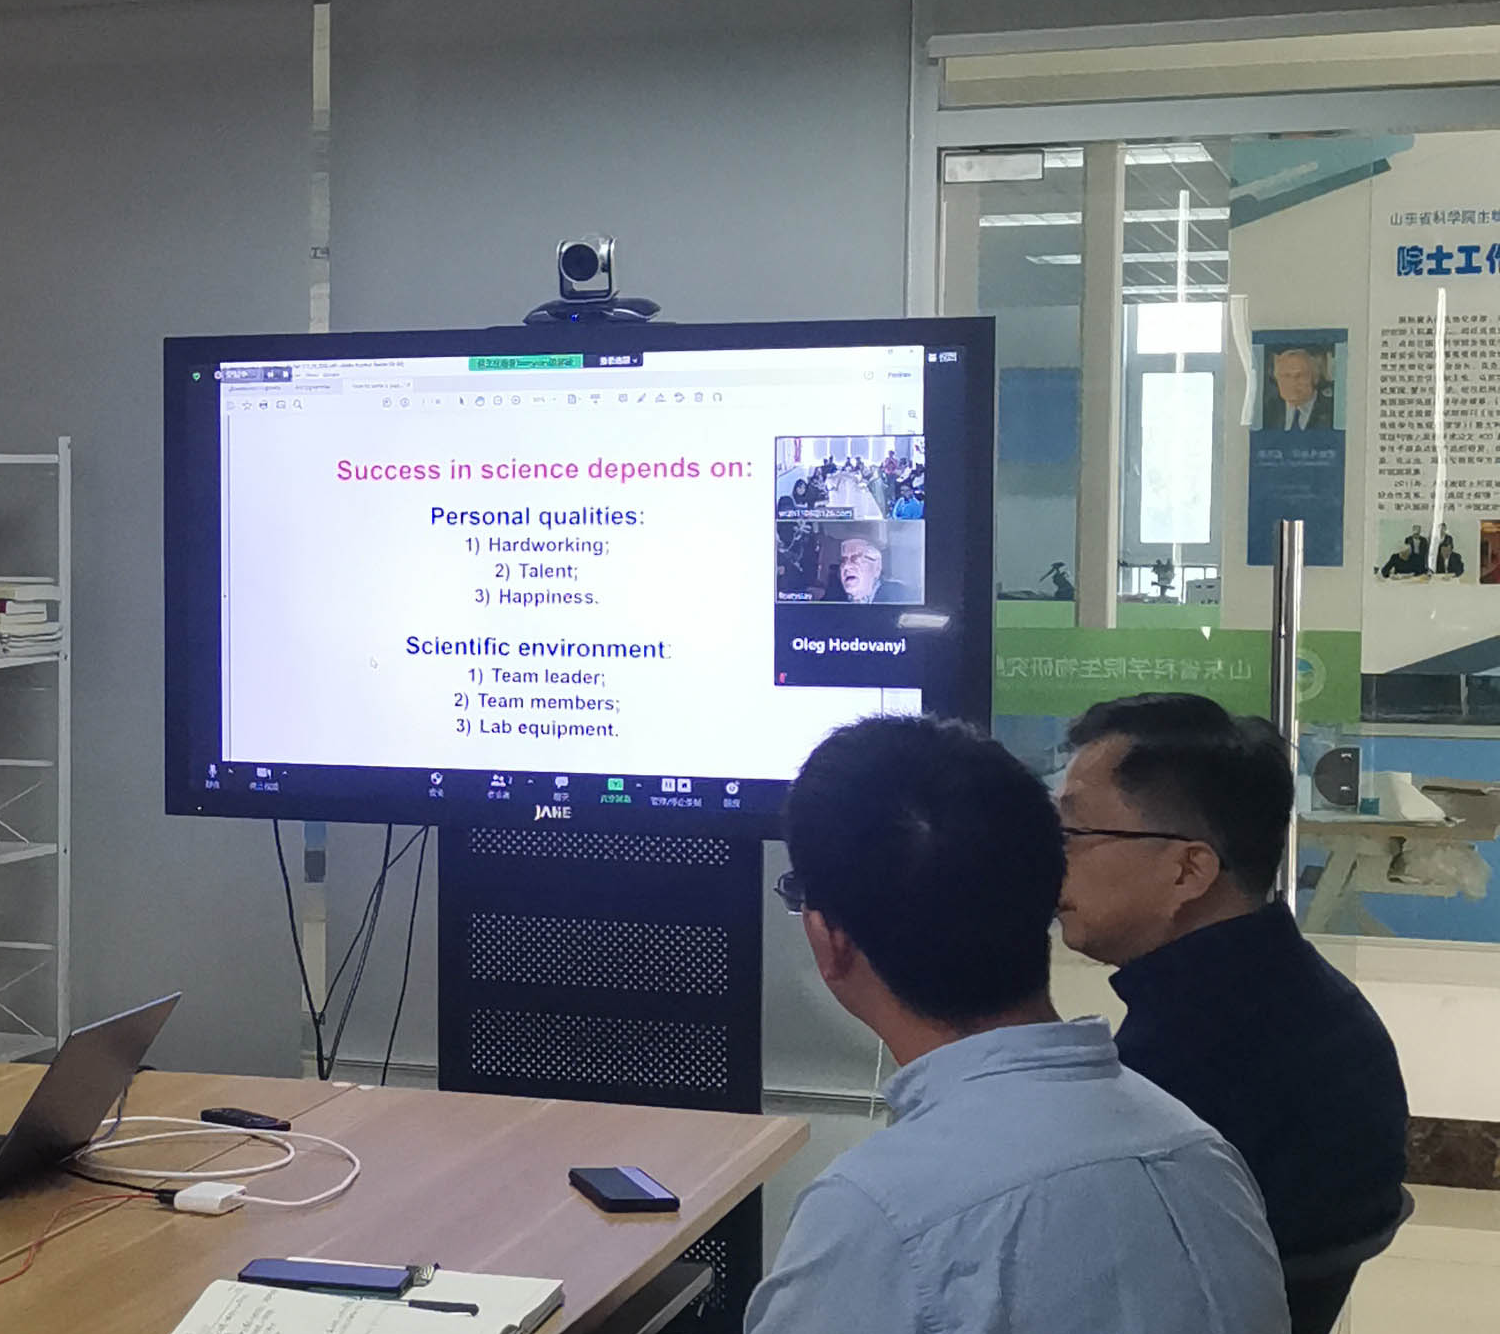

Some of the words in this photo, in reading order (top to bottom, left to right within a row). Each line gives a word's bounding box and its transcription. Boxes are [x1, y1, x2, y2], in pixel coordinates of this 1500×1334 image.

[336, 459, 441, 481] Success
[451, 459, 472, 479] in
[481, 458, 579, 480] science
[588, 457, 700, 483] depends
[710, 459, 753, 478] on:
[430, 506, 530, 526] Personal
[539, 506, 645, 530] qualities:
[465, 537, 480, 555] 1)
[488, 537, 610, 556] Hardworking;
[495, 563, 510, 582] 2)
[518, 563, 578, 581] Talent;
[475, 588, 490, 607] 3)
[499, 588, 600, 608] Happiness.
[405, 635, 511, 656] Scientific
[792, 638, 826, 654] Oleg
[468, 668, 483, 685] 1)
[492, 668, 539, 684] Team
[545, 668, 606, 687] leader;
[454, 692, 469, 711] 2)
[478, 693, 524, 709] Team
[531, 694, 620, 713] members;
[456, 719, 472, 736] 3)
[480, 719, 512, 735] Lab
[518, 720, 619, 739] equipment.
